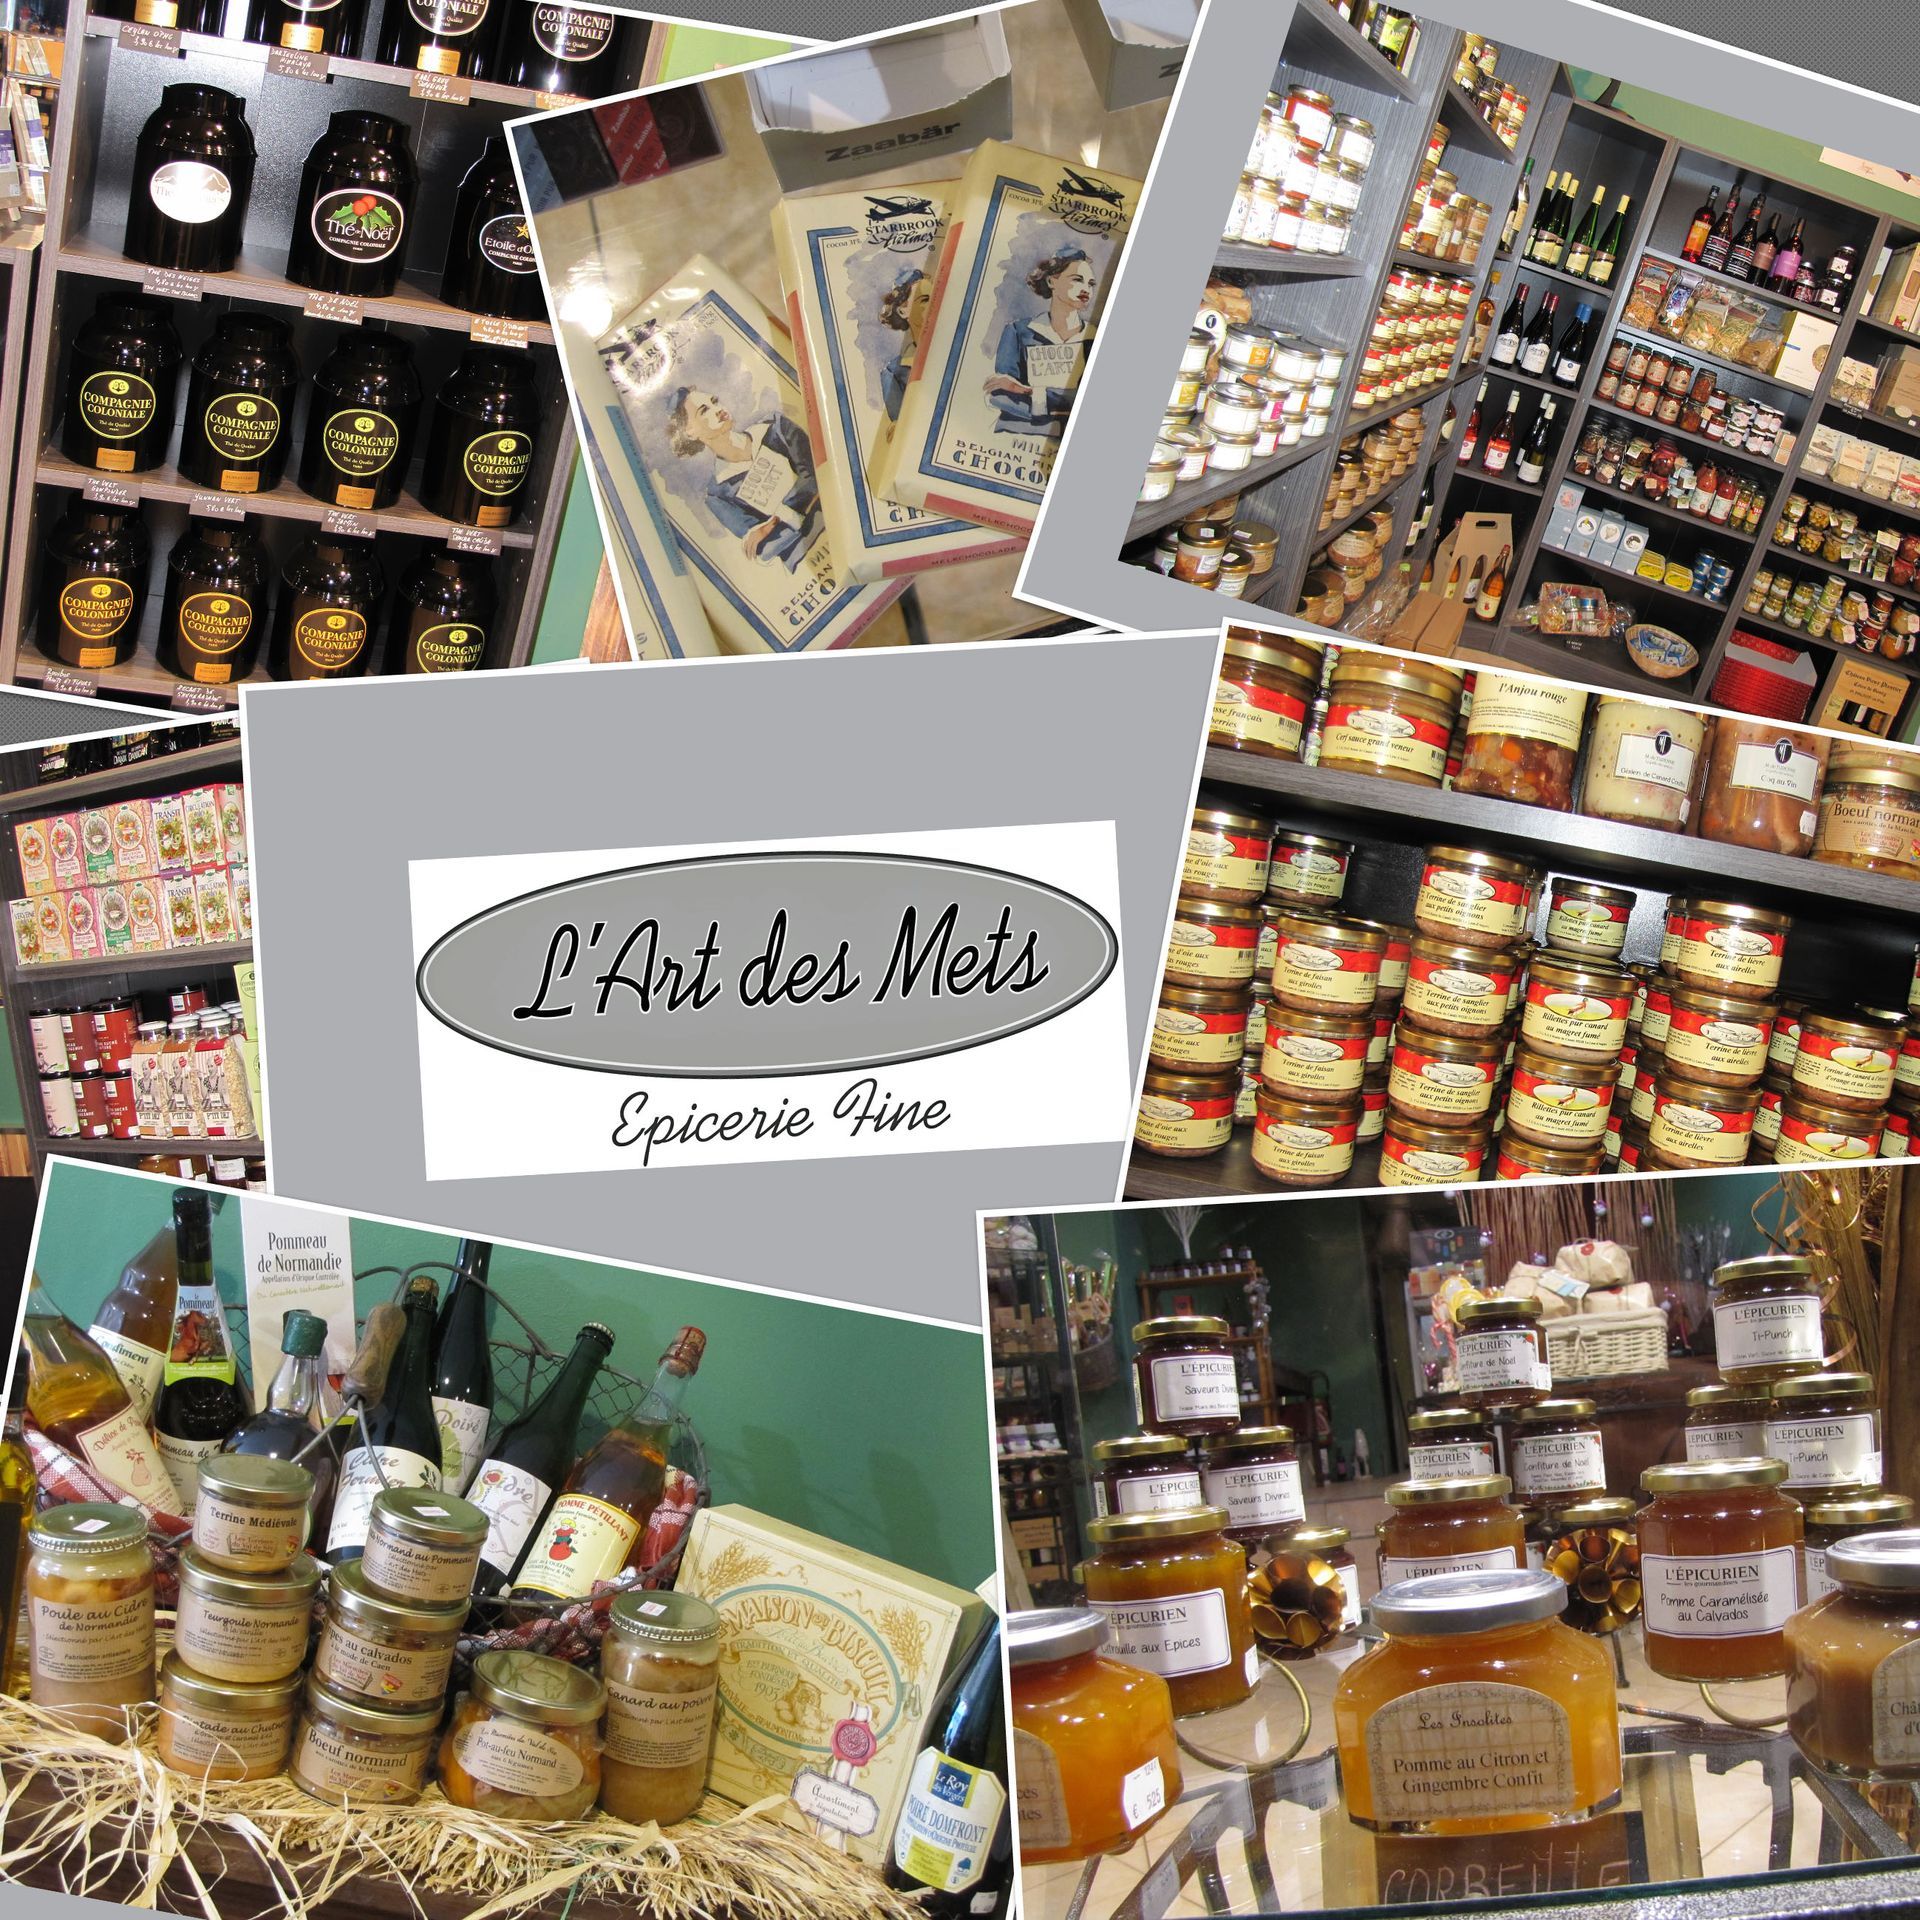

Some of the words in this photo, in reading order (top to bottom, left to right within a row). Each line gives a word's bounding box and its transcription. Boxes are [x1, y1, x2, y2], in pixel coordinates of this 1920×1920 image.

[538, 9, 611, 30] COMPAGNIE
[542, 21, 604, 40] COLONIALE
[824, 120, 960, 163] Zaabär
[1050, 194, 1128, 222] STARBROOK
[865, 219, 944, 236] STARBROOK
[1061, 209, 1115, 231] Airlines
[326, 218, 355, 237] Thé
[360, 222, 395, 241] Noël
[328, 236, 359, 247] COMPAGNIE
[485, 237, 516, 252] Etoile
[879, 231, 935, 250] Airlines
[1030, 348, 1074, 362] CHOCO
[1032, 362, 1074, 376] L'ART
[83, 392, 152, 409] COMPAGNIE
[87, 404, 146, 419] COLONIALE
[209, 413, 277, 430] COMPAGNIE
[213, 426, 271, 440] COLONIALE
[328, 429, 395, 447] COMPAGNIE
[331, 440, 389, 456] COLONIALE
[955, 439, 1022, 463] BELGIAN
[469, 452, 530, 465] COMPAGNIE
[473, 464, 525, 475] COLONIALE
[780, 564, 833, 616] BELGIAN
[65, 596, 131, 611] COMPAGNIE
[69, 608, 125, 619] COLONIALE
[184, 609, 249, 626] COMPAGNIE
[187, 620, 243, 635] COLONIALE
[300, 626, 364, 641] COMPAGNIE
[304, 637, 358, 650] COLONIALE
[422, 640, 483, 655] COMPAGNIE
[425, 652, 477, 664] COLONIALE
[1499, 683, 1538, 698] l'Anjou
[1540, 688, 1568, 704] rouge
[1226, 707, 1263, 723] français
[1349, 736, 1366, 745] sauce
[1391, 741, 1414, 753] veneur
[154, 808, 181, 820] TRANSIT
[1834, 804, 1873, 818] Boeuf
[512, 921, 723, 1020] L'Art
[738, 908, 862, 1008] des
[870, 902, 1051, 1005] Mets
[1426, 990, 1451, 1002] Terrine
[1461, 998, 1489, 1008] sanglier
[1439, 1001, 1459, 1012] petits
[1461, 1005, 1488, 1015] oignons
[1542, 1012, 1568, 1026] Rillettes
[1570, 1020, 1581, 1029] pur
[1582, 1021, 1608, 1031] canard
[1556, 1026, 1582, 1039] magret
[1582, 1031, 1601, 1040] fumé
[611, 1090, 814, 1168] Epicerie
[833, 1077, 951, 1138] Fine
[1156, 1122, 1171, 1132] d'oie
[1662, 1124, 1686, 1137] Terrine
[1687, 1132, 1695, 1140] de
[1696, 1133, 1715, 1143] lièvre
[1273, 1145, 1295, 1156] Terrine
[1304, 1151, 1324, 1159] faisan
[1666, 1136, 1678, 1144] aux
[1679, 1138, 1704, 1151] airelles
[1291, 1158, 1316, 1167] girolles
[268, 1232, 327, 1250] Pommeau
[258, 1258, 272, 1273] de
[275, 1252, 342, 1272] Normandie
[179, 1296, 215, 1309] Pommeau
[1734, 1304, 1805, 1320] L'ÉPICURIEN
[1753, 1329, 1793, 1341] Ti-Punch
[95, 1335, 150, 1366] Condiment
[433, 1406, 482, 1434] Poiré
[1775, 1425, 1844, 1440] L'ÉPICURIEN
[1524, 1460, 1559, 1471] Confiture
[1562, 1459, 1572, 1467] de
[1790, 1451, 1828, 1462] Ti-Punch
[1225, 1470, 1289, 1485] L'ÉPICURIEN
[1228, 1495, 1262, 1506] Saveurs
[210, 1506, 246, 1525] Terrine
[250, 1517, 297, 1527] Médiévale
[375, 1535, 413, 1558] Normand
[431, 1553, 472, 1565] Pommeau
[1665, 1564, 1760, 1581] L'ÉPICURIEN
[1660, 1593, 1695, 1607] Pomme
[1700, 1592, 1769, 1606] Caramélisée
[41, 1606, 83, 1620] Poule
[87, 1611, 112, 1620] au
[203, 1610, 251, 1627] Teurgoule
[253, 1617, 299, 1628] Normande
[1678, 1611, 1692, 1622] au
[1696, 1609, 1749, 1622] Calvados
[59, 1622, 74, 1631] de
[76, 1616, 137, 1632] Normandie
[345, 1641, 358, 1651] au
[361, 1646, 412, 1664] calvados
[725, 1595, 814, 1637] MAISON
[821, 1614, 894, 1705] BISCUIT
[1141, 1643, 1160, 1654] aux
[1164, 1637, 1201, 1653] Epices
[607, 1686, 656, 1710] Canard
[659, 1702, 680, 1710] au
[1418, 1713, 1443, 1730] Les
[1449, 1710, 1513, 1729] Insolites
[309, 1729, 344, 1757] Boeuf
[345, 1751, 408, 1768] normand
[476, 1737, 517, 1759] Pot-au-feu
[518, 1749, 557, 1768] Normand
[1393, 1759, 1453, 1774] Pomme
[1457, 1758, 1475, 1769] au
[1481, 1753, 1530, 1769] Citron
[1535, 1751, 1550, 1765] et
[935, 1770, 945, 1782] Le
[946, 1772, 969, 1793] Roy
[1402, 1776, 1488, 1795] Gingembre
[1492, 1772, 1544, 1787] Confit
[812, 1783, 861, 1814] Assortiment
[932, 1782, 942, 1792] des
[942, 1785, 966, 1804] Vergers
[907, 1795, 930, 1823] POIRÉ
[931, 1811, 988, 1843] DOMFRONT
